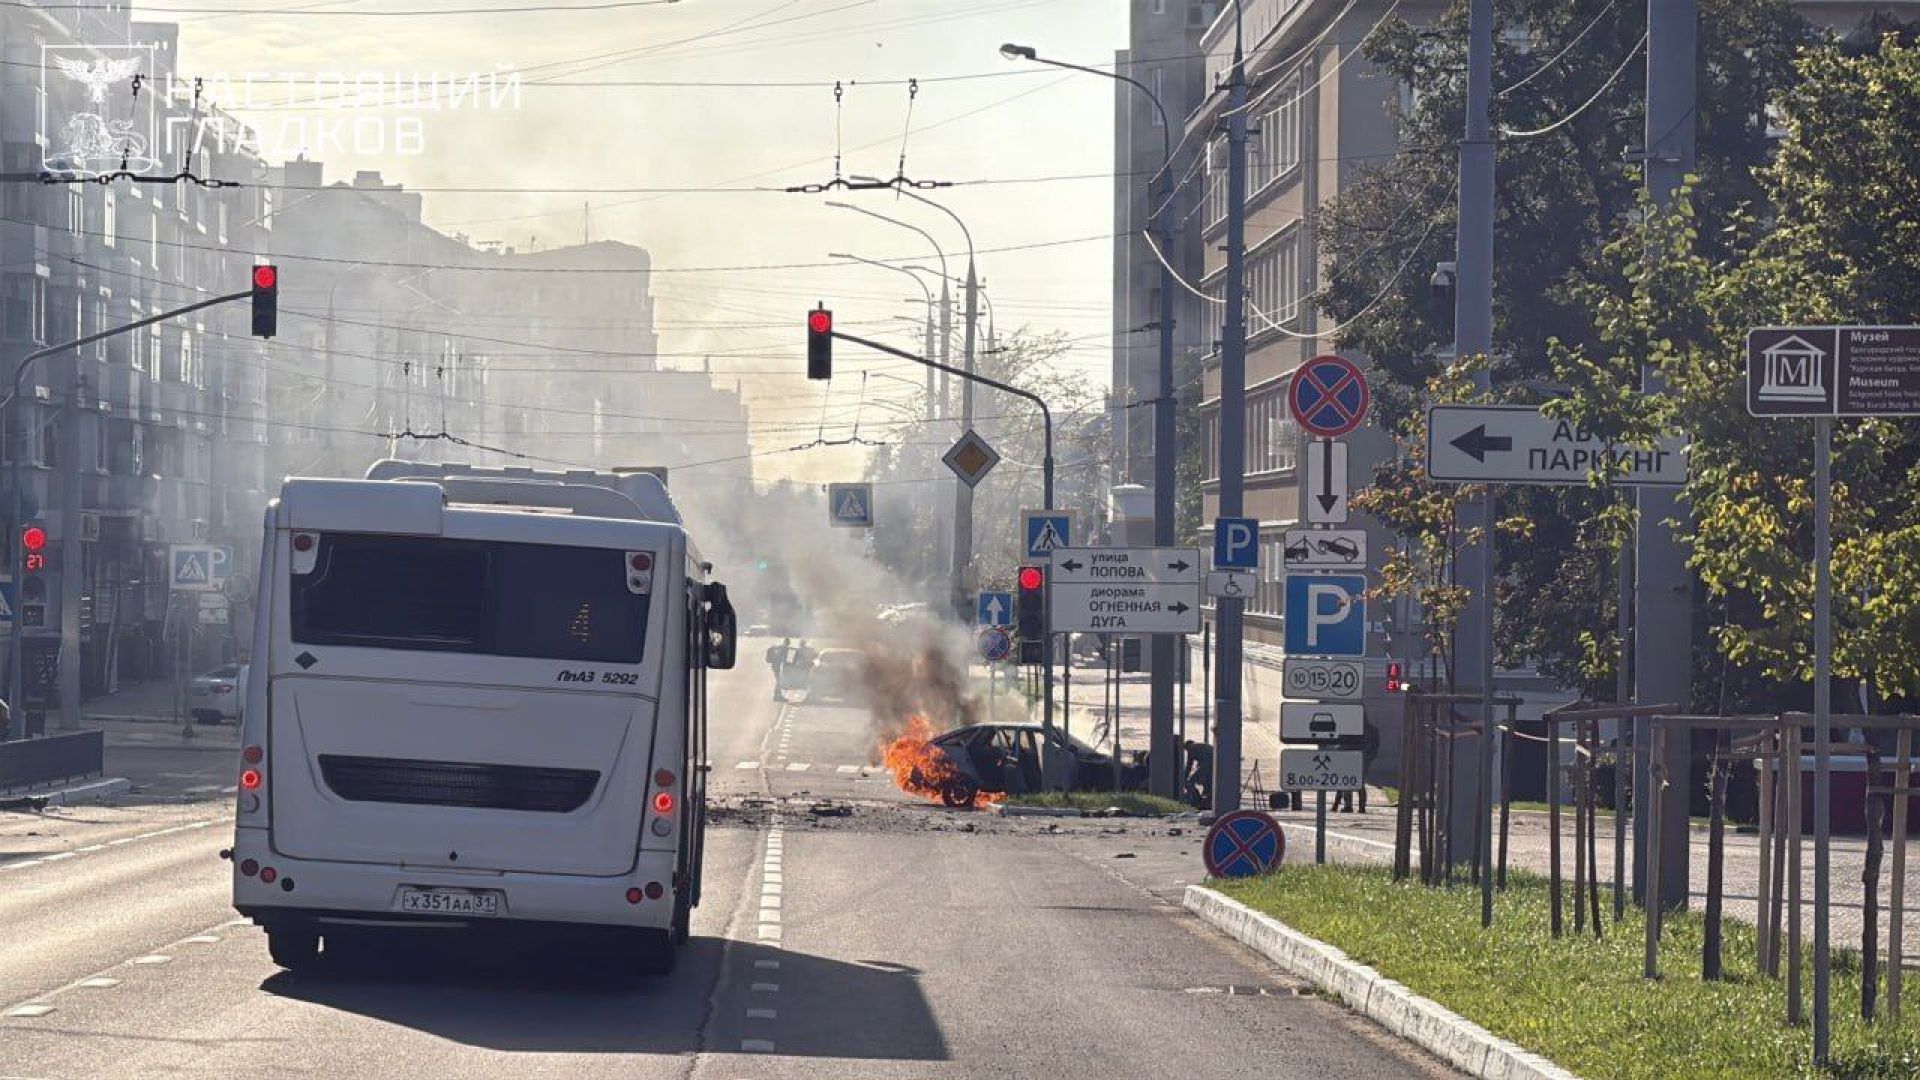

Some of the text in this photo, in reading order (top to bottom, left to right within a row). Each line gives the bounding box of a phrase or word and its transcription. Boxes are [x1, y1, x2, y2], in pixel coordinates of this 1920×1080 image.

[1850, 331, 1889, 344] Музей
[1849, 377, 1900, 388] Museum
[1226, 523, 1252, 563] P
[1091, 553, 1129, 563] улица
[1090, 566, 1146, 577] ПОПОВА
[1090, 587, 1146, 599] диорама
[1089, 601, 1162, 613] ОГНЕННАЯ
[1307, 584, 1351, 647] P
[1090, 617, 1126, 628] ДУГА
[601, 672, 640, 685] 5292
[1294, 671, 1355, 688] 10 15 20
